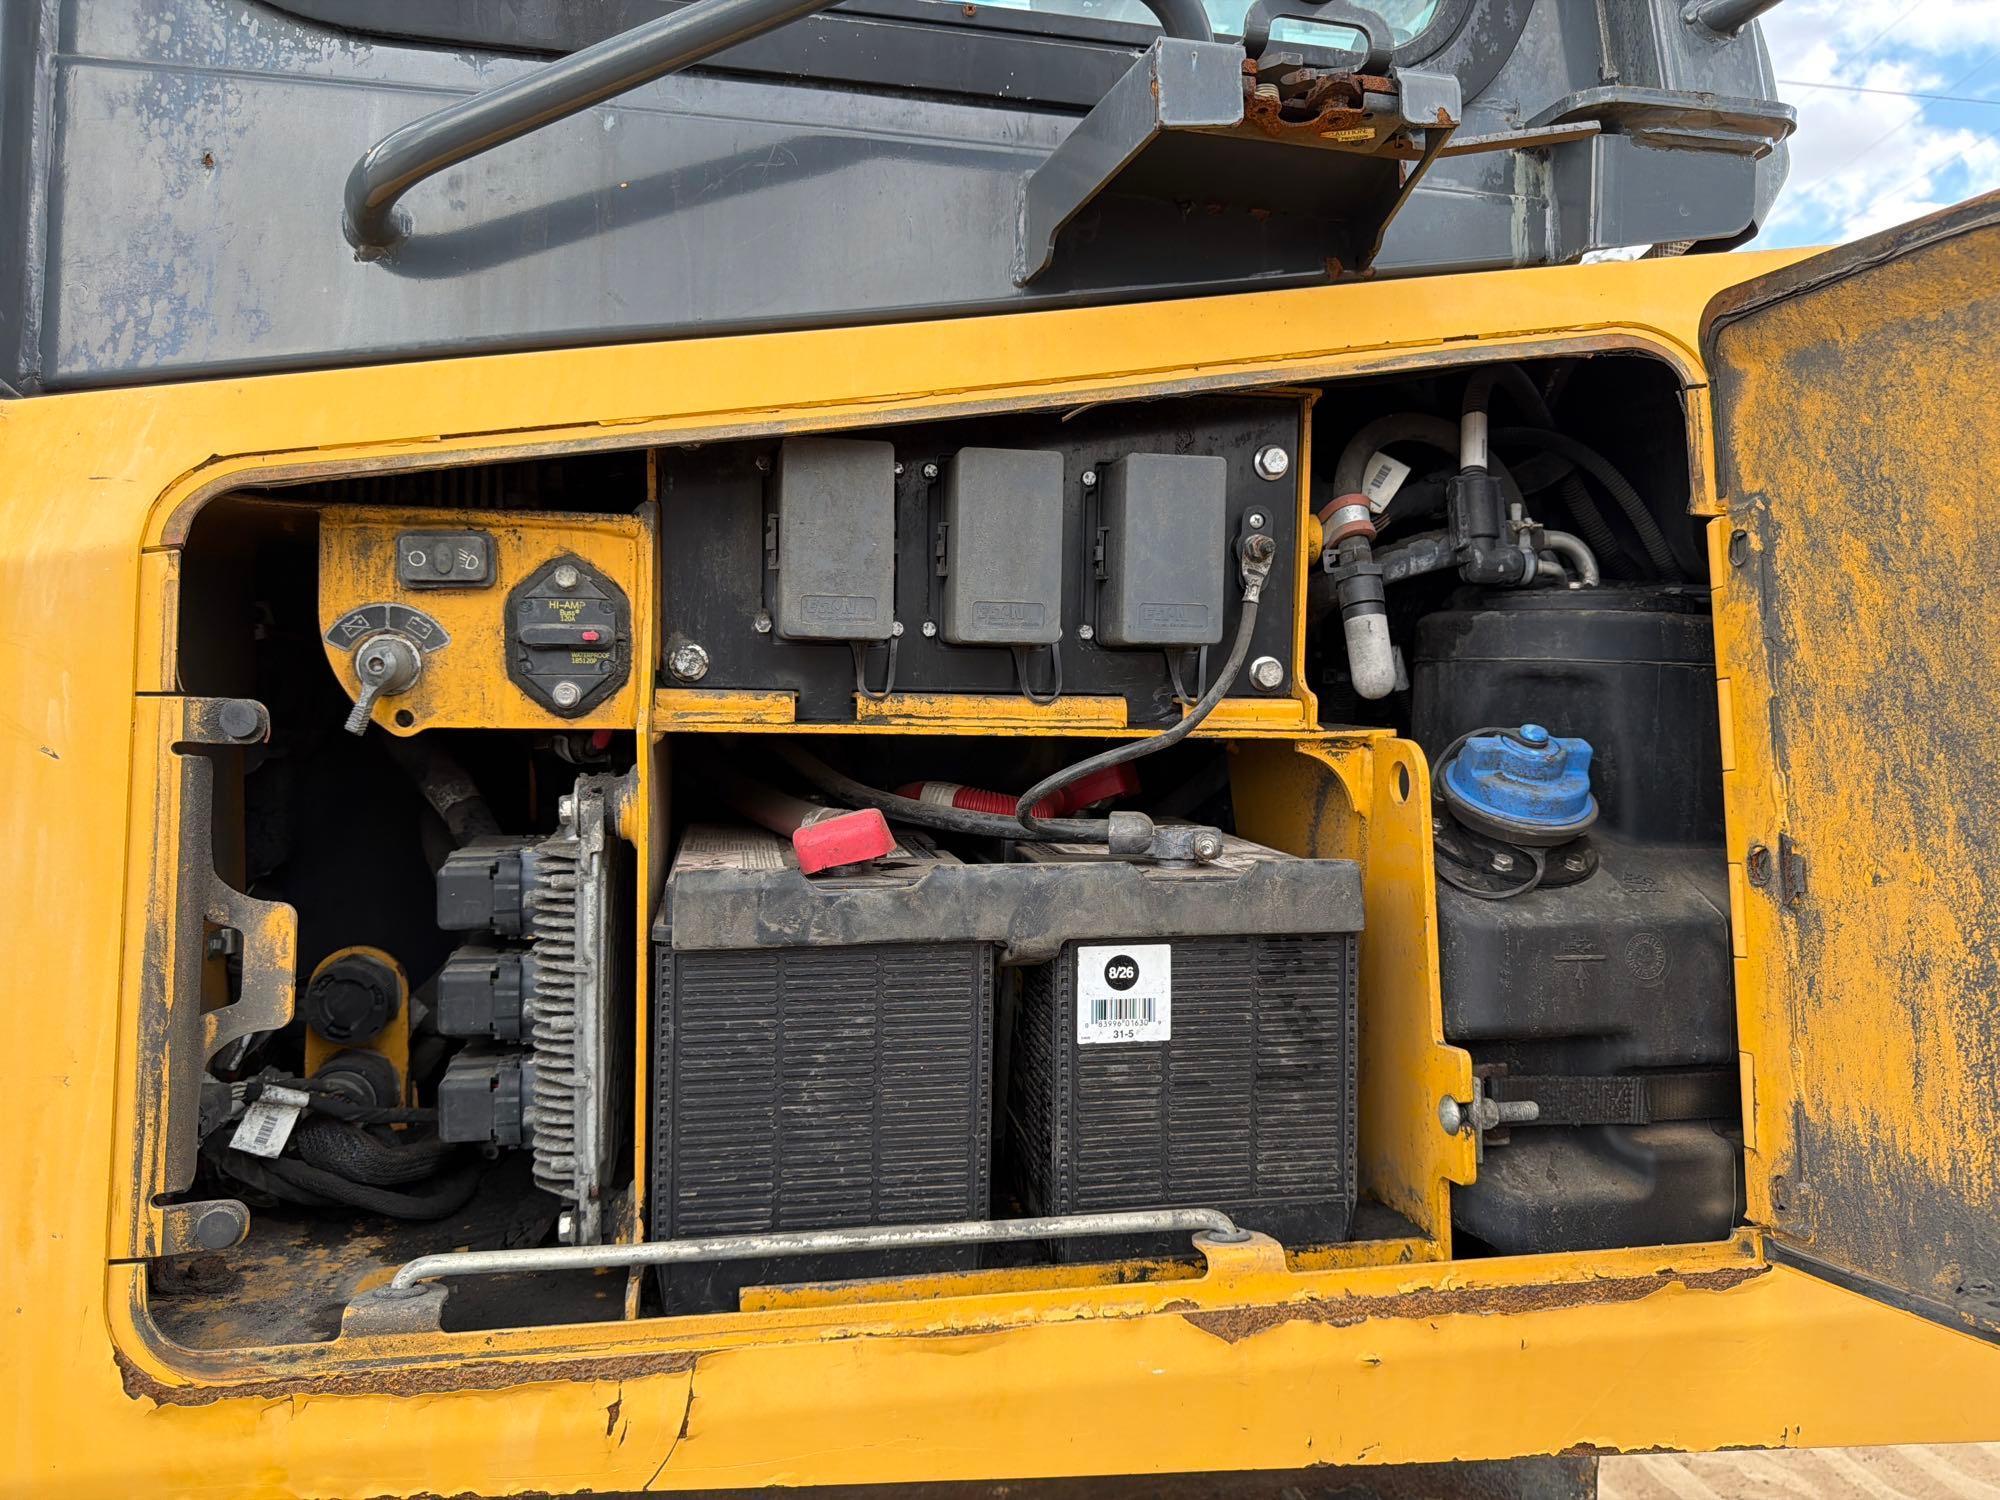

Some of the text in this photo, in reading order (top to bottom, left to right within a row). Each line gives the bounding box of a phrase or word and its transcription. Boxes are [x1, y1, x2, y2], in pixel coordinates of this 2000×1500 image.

[549, 601, 586, 609] HI-AMP
[1108, 966, 1134, 979] 8/26
[1113, 1030, 1134, 1039] 31-5
